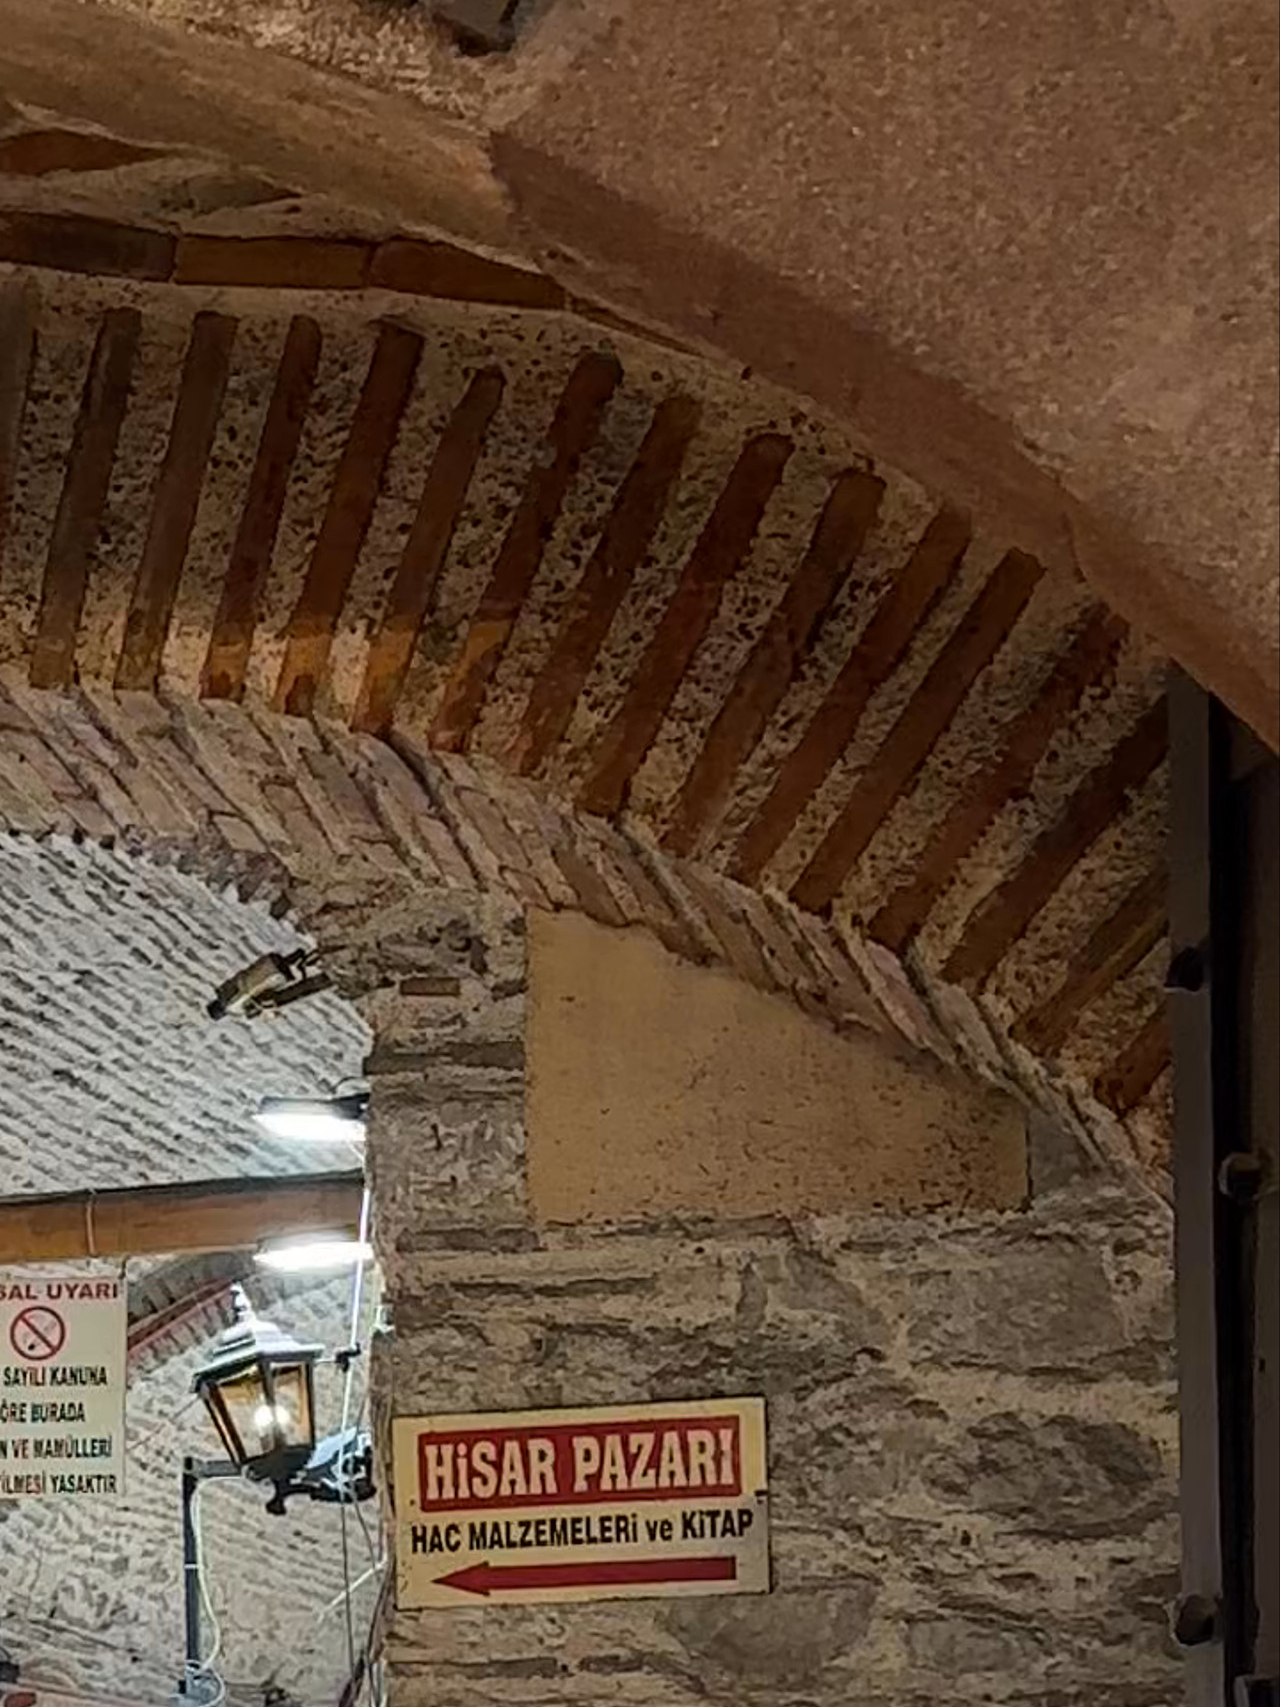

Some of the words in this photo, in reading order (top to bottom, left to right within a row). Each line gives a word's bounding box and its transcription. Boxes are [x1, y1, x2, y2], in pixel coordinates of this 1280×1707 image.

[47, 1282, 118, 1299] UYARI
[31, 1403, 86, 1422] BURADA
[12, 1439, 28, 1458] VE
[572, 1428, 734, 1493] PAZARI
[411, 1524, 461, 1554] HAC
[645, 1520, 673, 1542] ve
